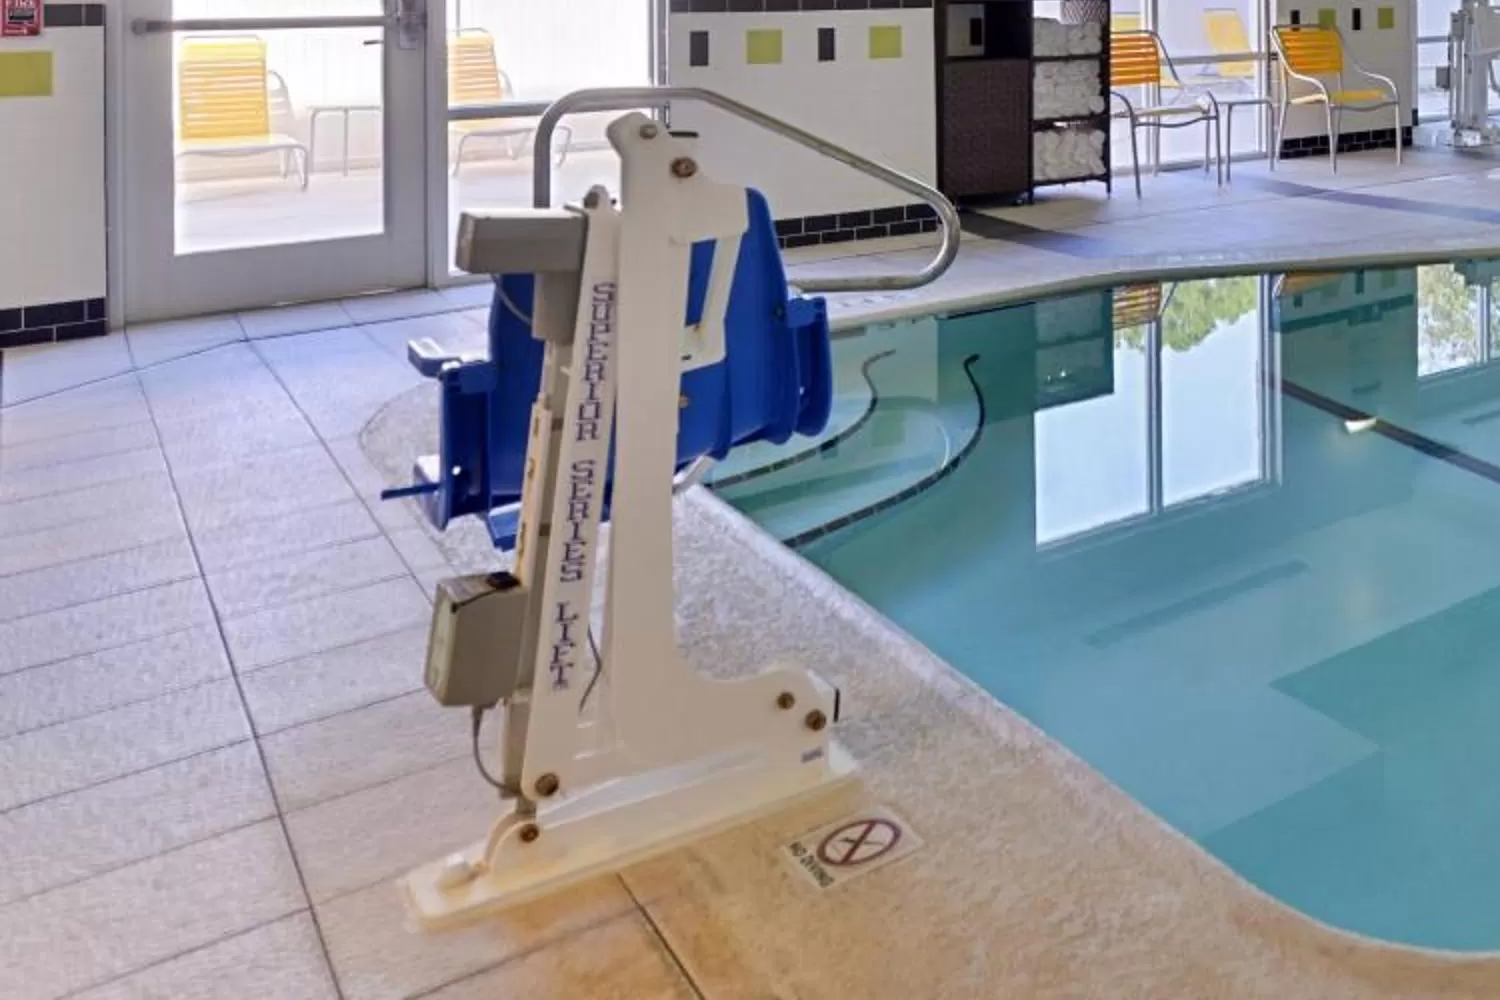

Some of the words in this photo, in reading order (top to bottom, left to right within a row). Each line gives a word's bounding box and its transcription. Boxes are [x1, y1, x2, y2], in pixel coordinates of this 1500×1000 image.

[575, 281, 617, 442] SUPERIOR
[560, 459, 596, 583] SERIES
[550, 602, 579, 690] LIFT
